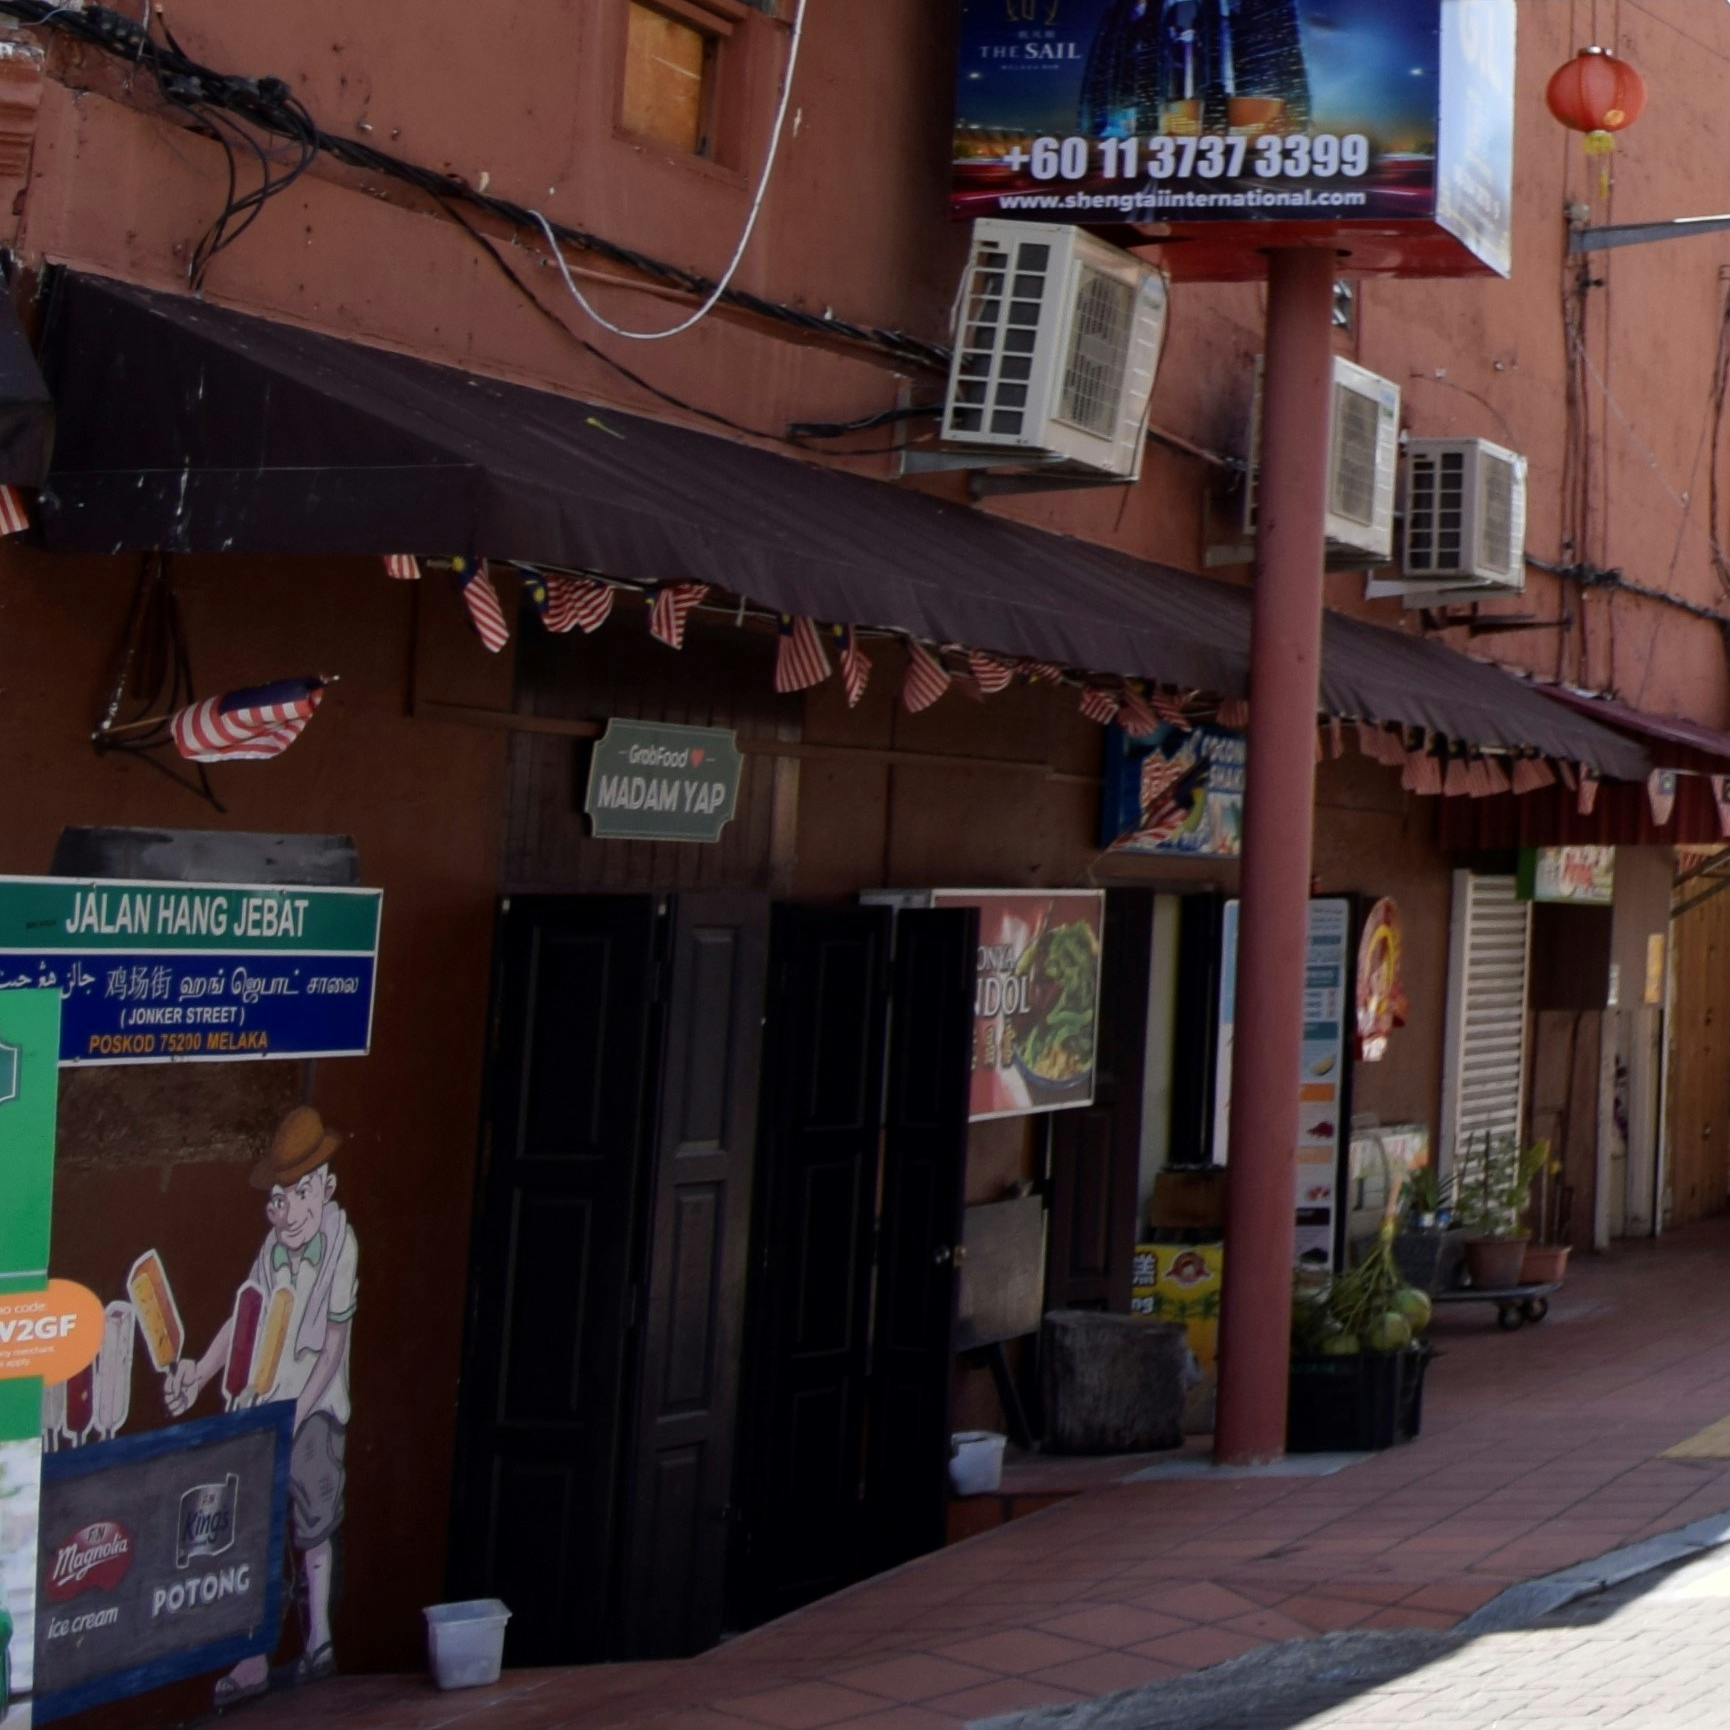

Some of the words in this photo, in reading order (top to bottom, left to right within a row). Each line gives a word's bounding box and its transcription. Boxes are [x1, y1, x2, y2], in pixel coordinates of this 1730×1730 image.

[979, 45, 1019, 59] THE
[1024, 42, 1083, 60] SAIL
[1002, 136, 1088, 180] +60
[1097, 138, 1138, 180] 11
[1147, 136, 1247, 180] 3737
[1254, 133, 1369, 180] 3399
[999, 189, 1366, 212] www.shengtaiinternational.com
[629, 744, 689, 769] GrabFood
[598, 775, 680, 813] MADAM
[683, 780, 726, 814] YAP
[66, 892, 151, 935] JALAN
[157, 895, 228, 937] HANG
[233, 898, 309, 938] JEBAT
[105, 966, 172, 1001] 鸡场街
[89, 1033, 154, 1055] POSKOD
[160, 1032, 202, 1052] 75200
[206, 1030, 269, 1050] MELAKA
[182, 1509, 230, 1546] Kings
[52, 1532, 129, 1586] Magnolia
[152, 1564, 250, 1618] POTONG
[47, 1616, 70, 1640] ice
[71, 1607, 119, 1634] cream
